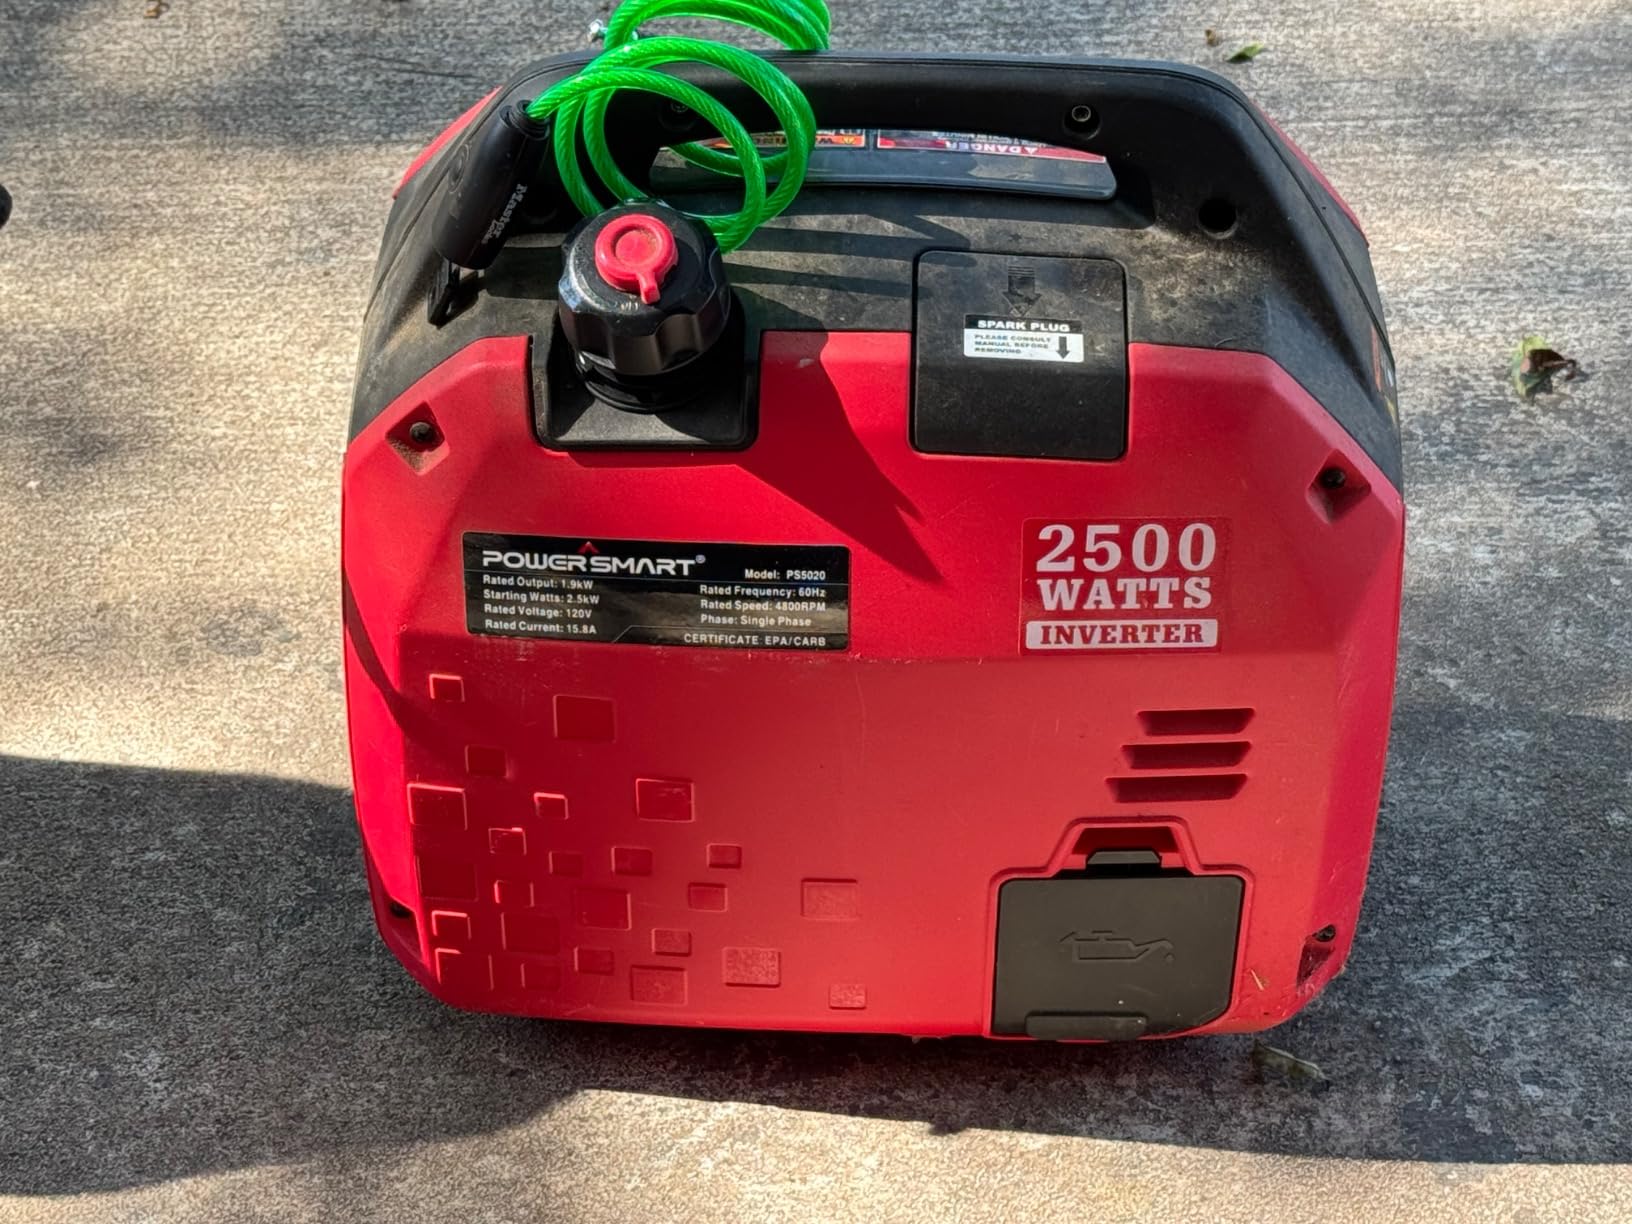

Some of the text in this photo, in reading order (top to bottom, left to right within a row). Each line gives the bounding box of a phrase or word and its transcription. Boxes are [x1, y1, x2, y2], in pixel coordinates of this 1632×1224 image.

[494, 183, 528, 239] Master
[977, 319, 1070, 333] SPARK PLUG
[974, 333, 1051, 343] PLEASE CONSULT
[1036, 522, 1216, 573] 2500
[483, 574, 594, 590] Rated Output: 1.9kW
[744, 568, 826, 581] Model: PS5020
[483, 590, 600, 605] Starting Watts: 2.5kW
[700, 584, 827, 598] Rated Frequency: 60Hz
[1036, 577, 1212, 611] WATTS
[484, 603, 592, 619] Rated Voltage: 120V
[700, 599, 826, 612] Rated Speed: 4800RPM
[485, 619, 597, 634] Rated Current: 15.8A
[700, 613, 812, 627] Phase: Single Phase
[765, 635, 826, 647] EPA/CARB
[1040, 623, 1204, 645] INVERTER
